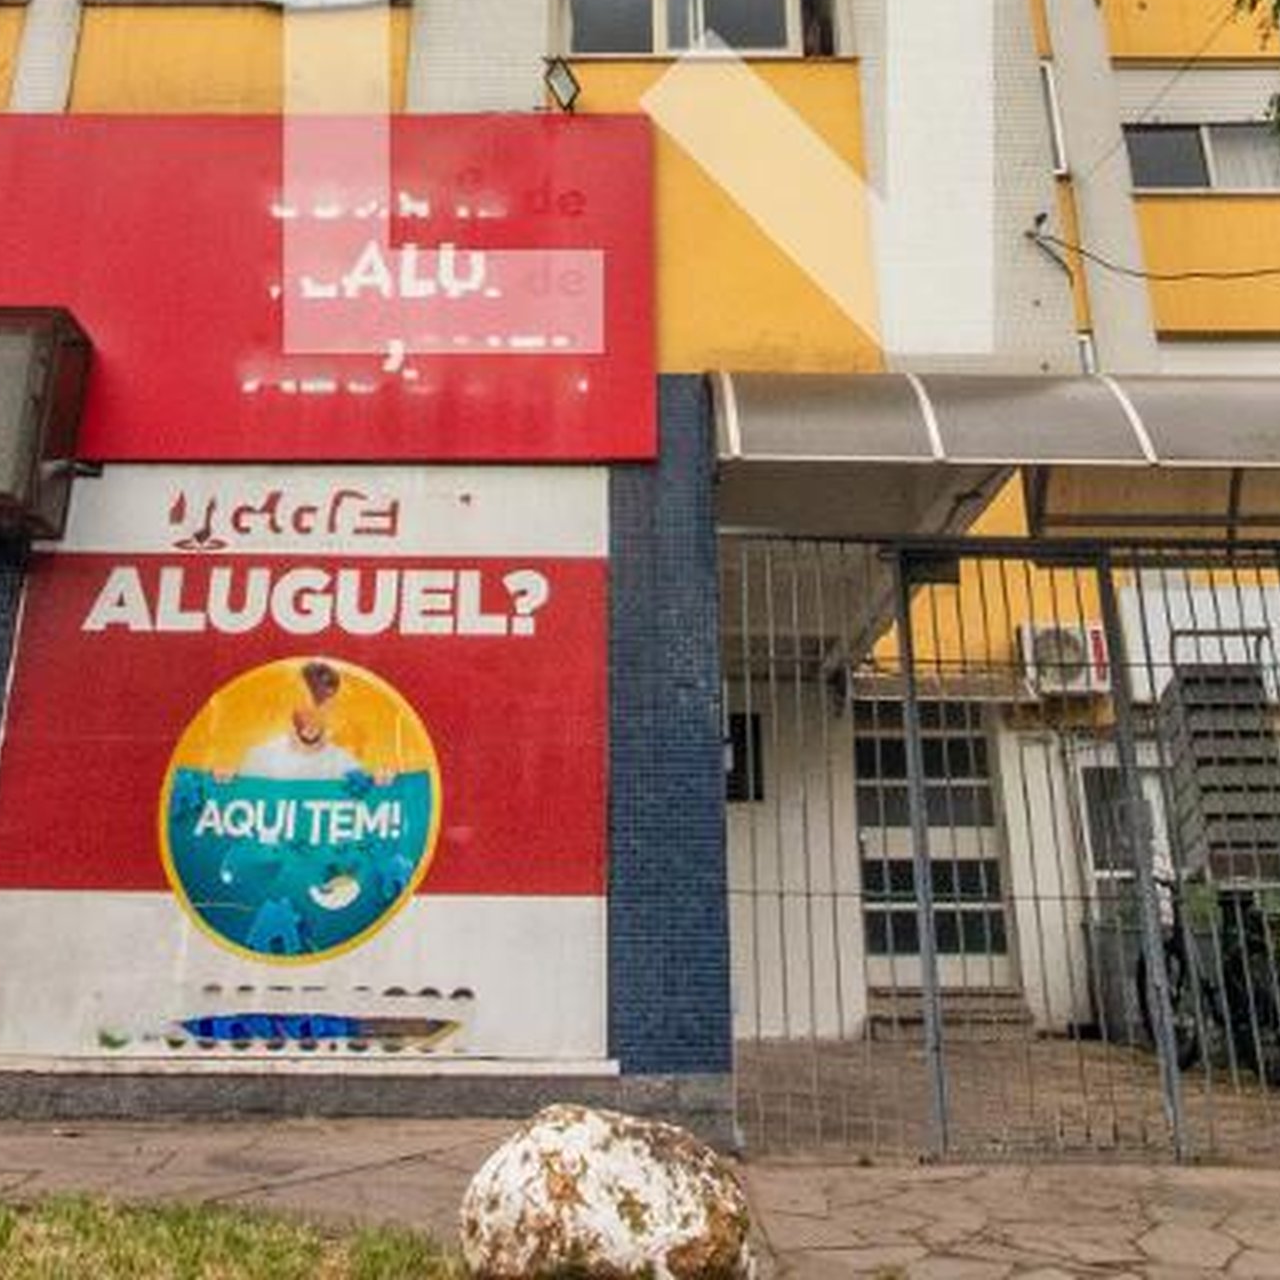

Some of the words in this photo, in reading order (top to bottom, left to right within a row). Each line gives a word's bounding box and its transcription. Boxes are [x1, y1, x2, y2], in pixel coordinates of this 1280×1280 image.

[82, 565, 550, 635] ALUGUEL?
[194, 799, 297, 844] AQUI
[305, 800, 403, 844] TEM!
